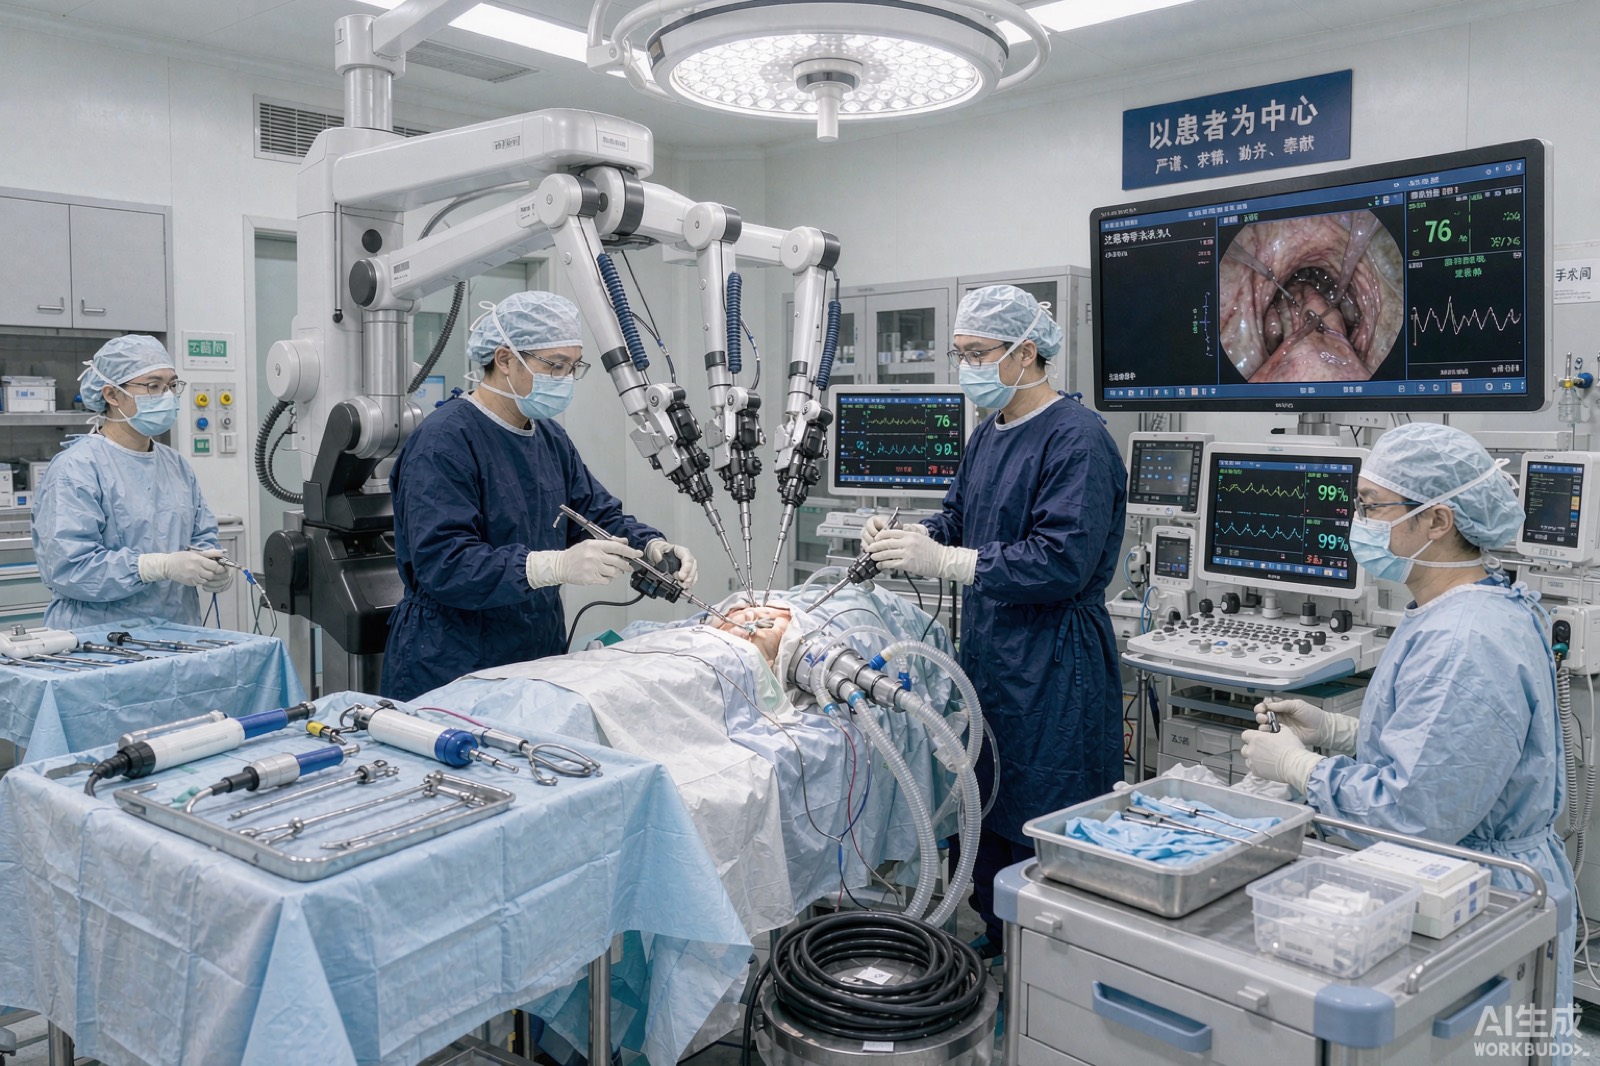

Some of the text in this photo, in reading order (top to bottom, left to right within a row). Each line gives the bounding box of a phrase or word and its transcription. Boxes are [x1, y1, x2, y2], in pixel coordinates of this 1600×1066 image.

[1149, 95, 1318, 150] 以患者为中心
[1424, 219, 1452, 243] 76
[1554, 266, 1592, 282] 手术间
[934, 414, 950, 428] 76
